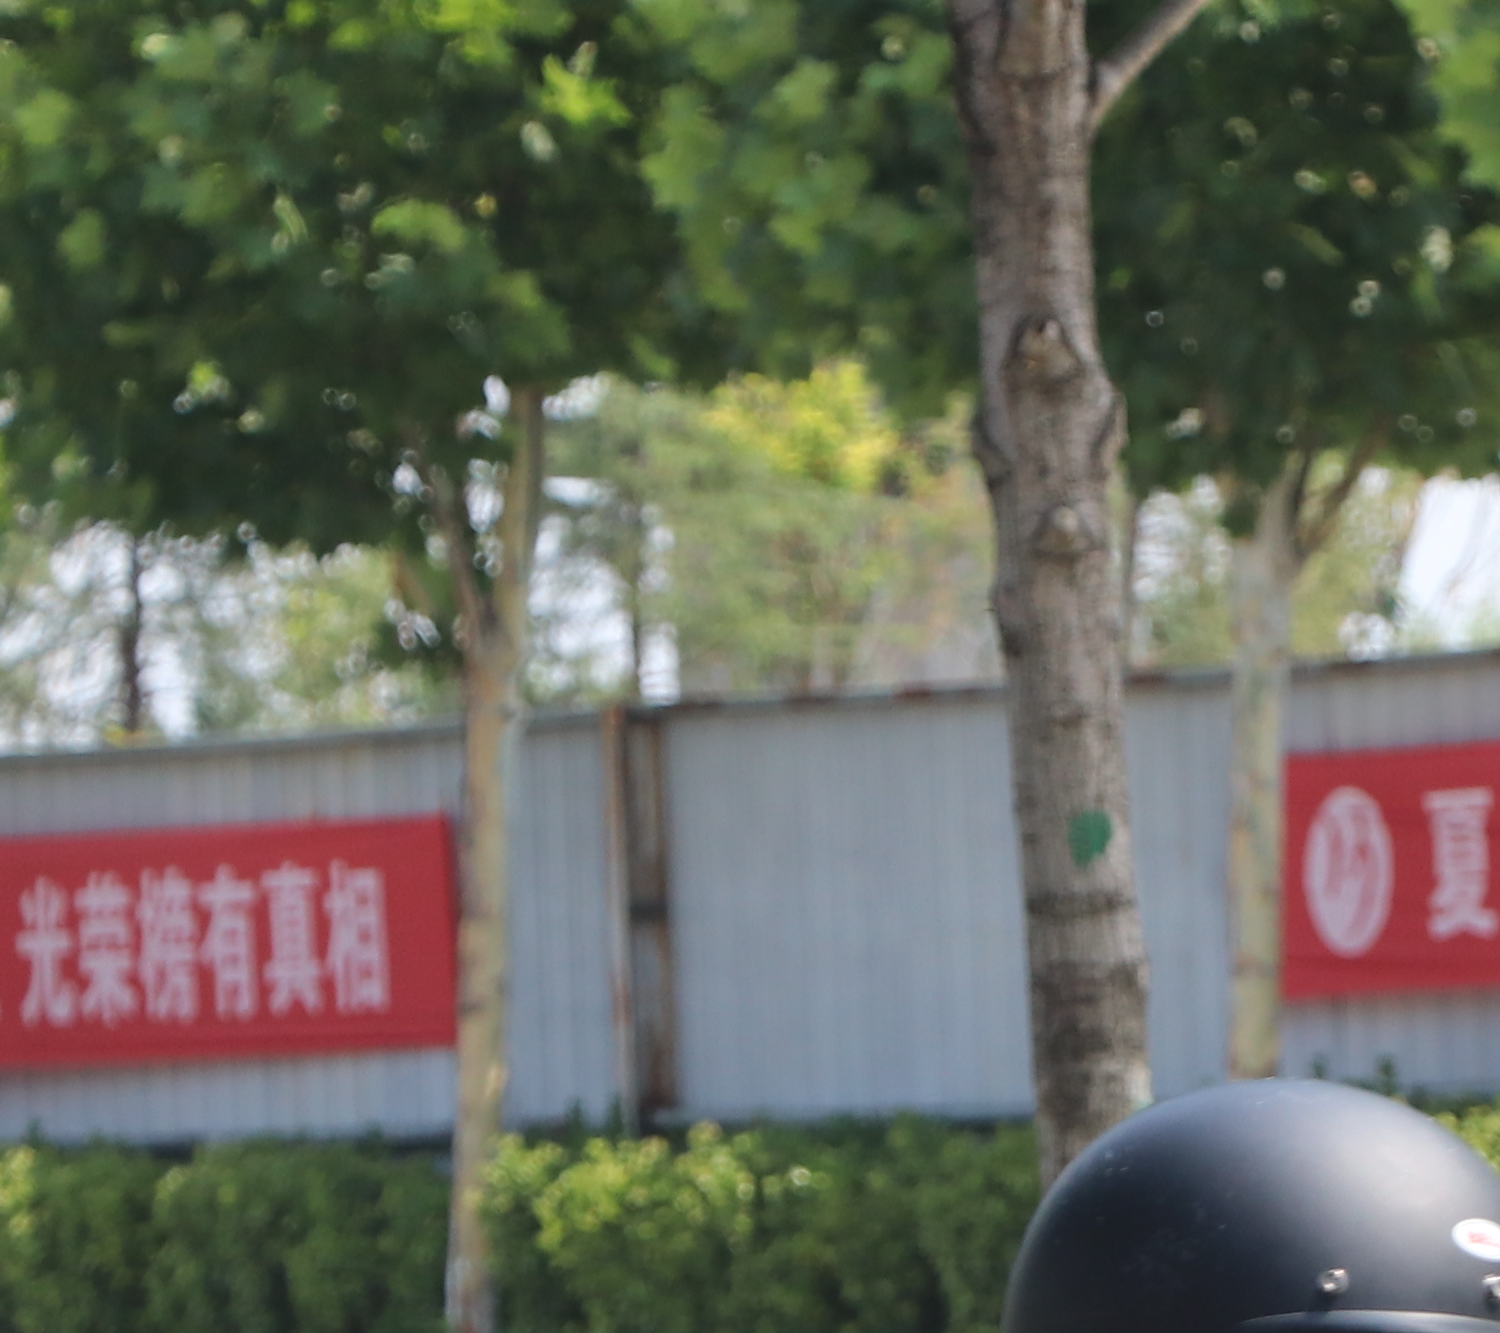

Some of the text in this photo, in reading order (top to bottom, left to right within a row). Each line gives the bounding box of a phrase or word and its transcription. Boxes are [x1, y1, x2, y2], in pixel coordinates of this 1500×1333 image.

[14, 857, 392, 1029] 光荣榜有真相
